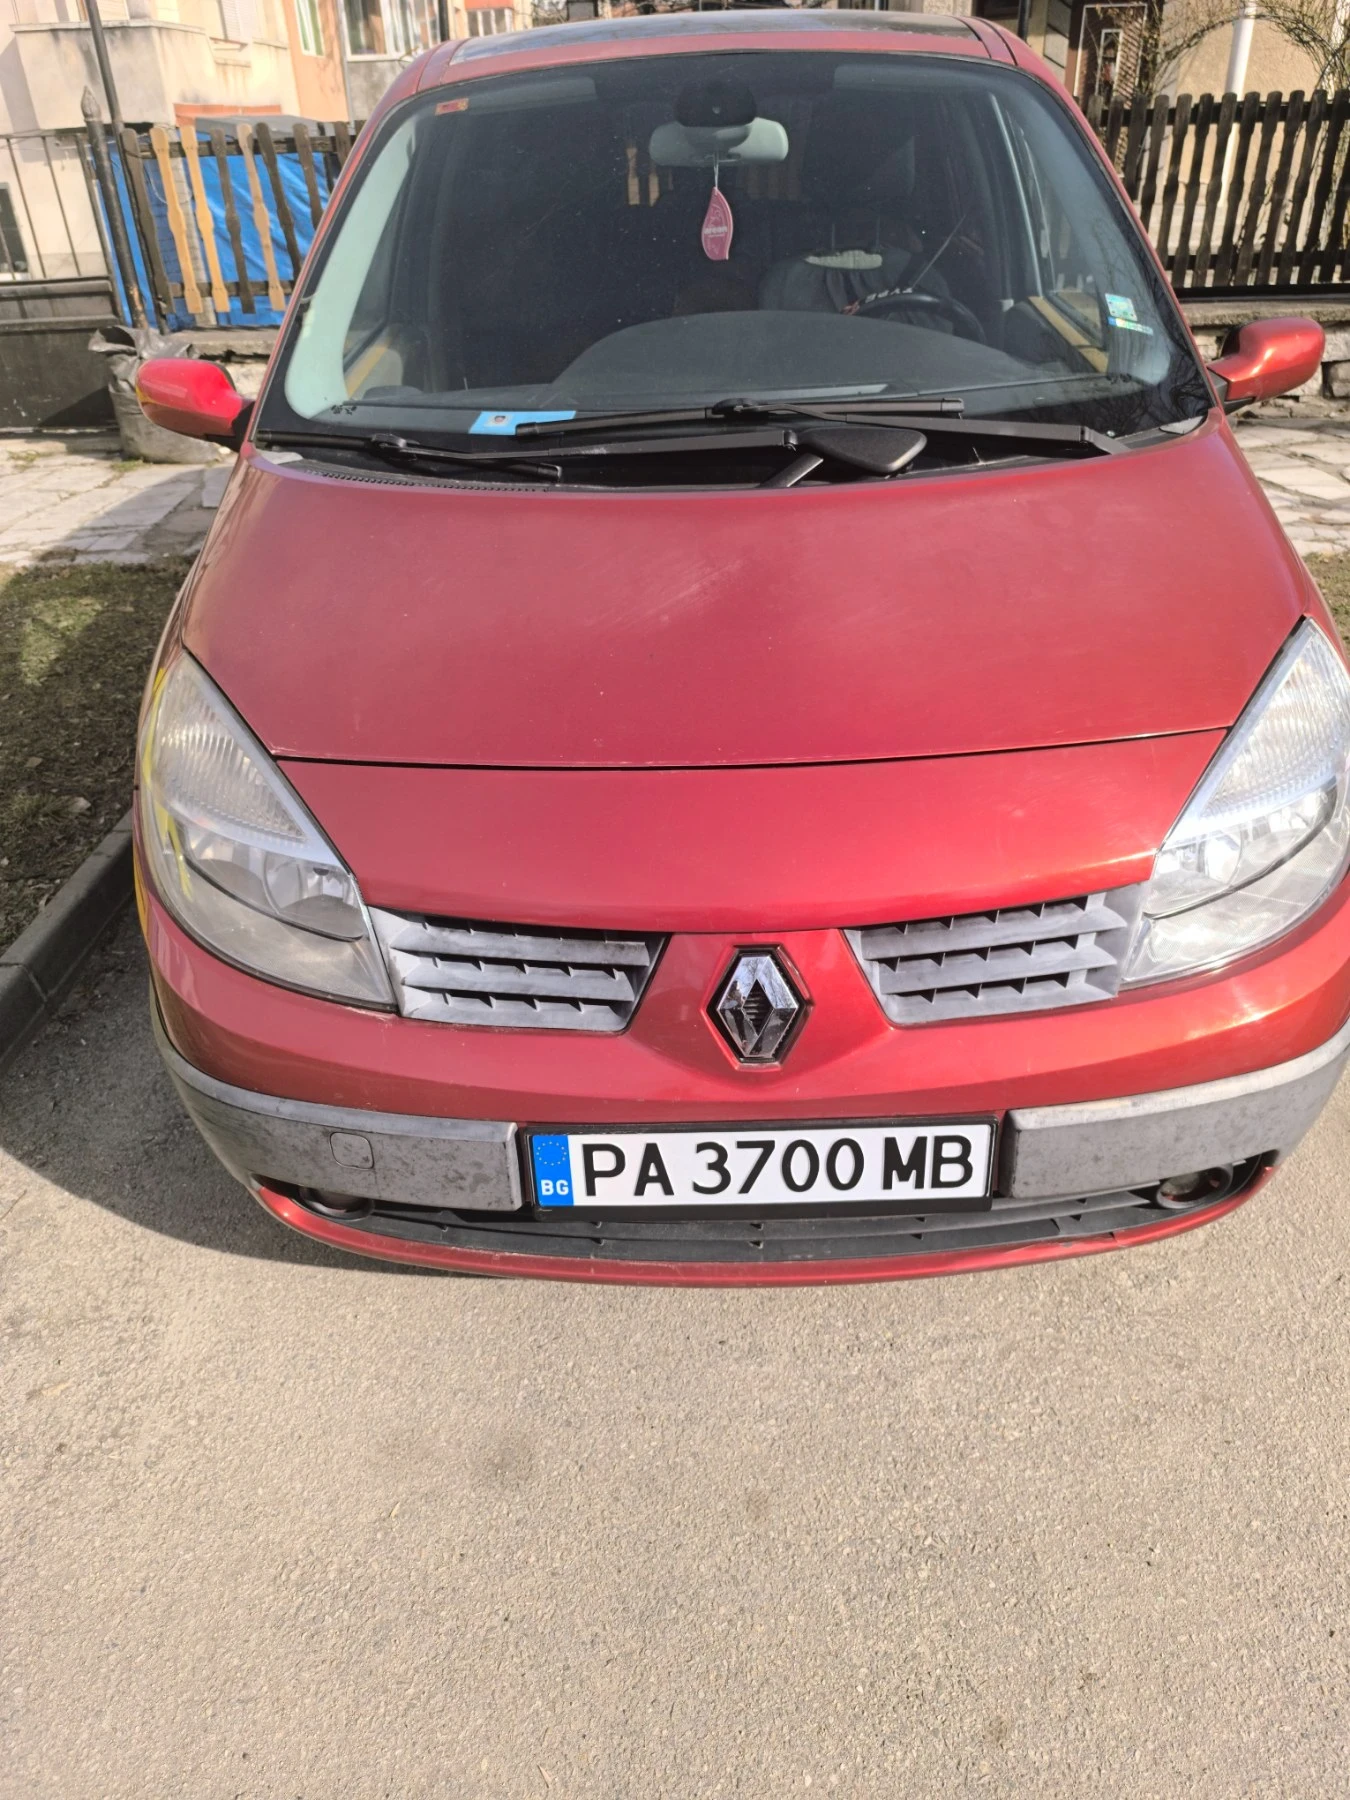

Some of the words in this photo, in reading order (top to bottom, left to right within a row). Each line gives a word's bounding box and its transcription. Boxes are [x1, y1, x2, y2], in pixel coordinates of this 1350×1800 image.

[583, 1142, 674, 1197] PA
[692, 1138, 865, 1195] 3700
[882, 1135, 974, 1190] MB
[540, 1179, 569, 1196] BG
